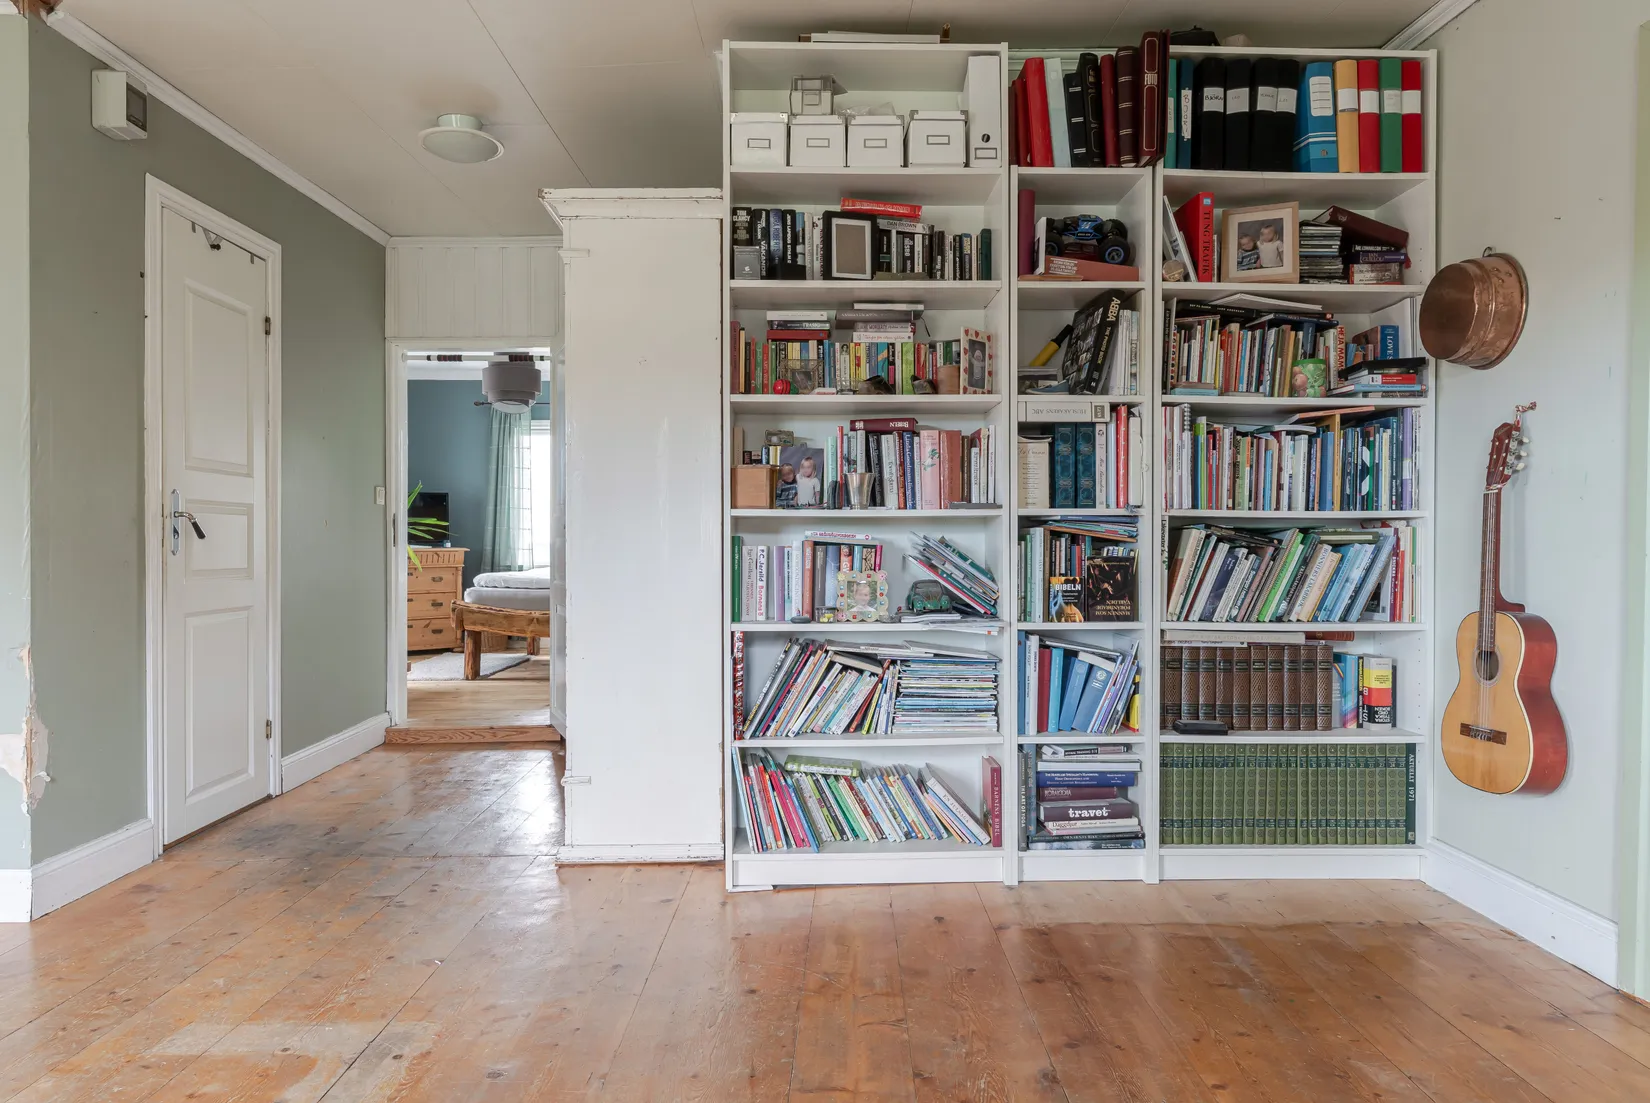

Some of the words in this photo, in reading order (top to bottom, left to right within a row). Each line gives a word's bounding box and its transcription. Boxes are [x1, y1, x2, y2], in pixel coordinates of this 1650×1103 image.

[1144, 73, 1158, 85] FOTO
[1201, 238, 1211, 275] TRAFIK
[1106, 296, 1121, 322] ABBA
[1386, 336, 1394, 355] LOVE
[1068, 807, 1111, 818] travet
